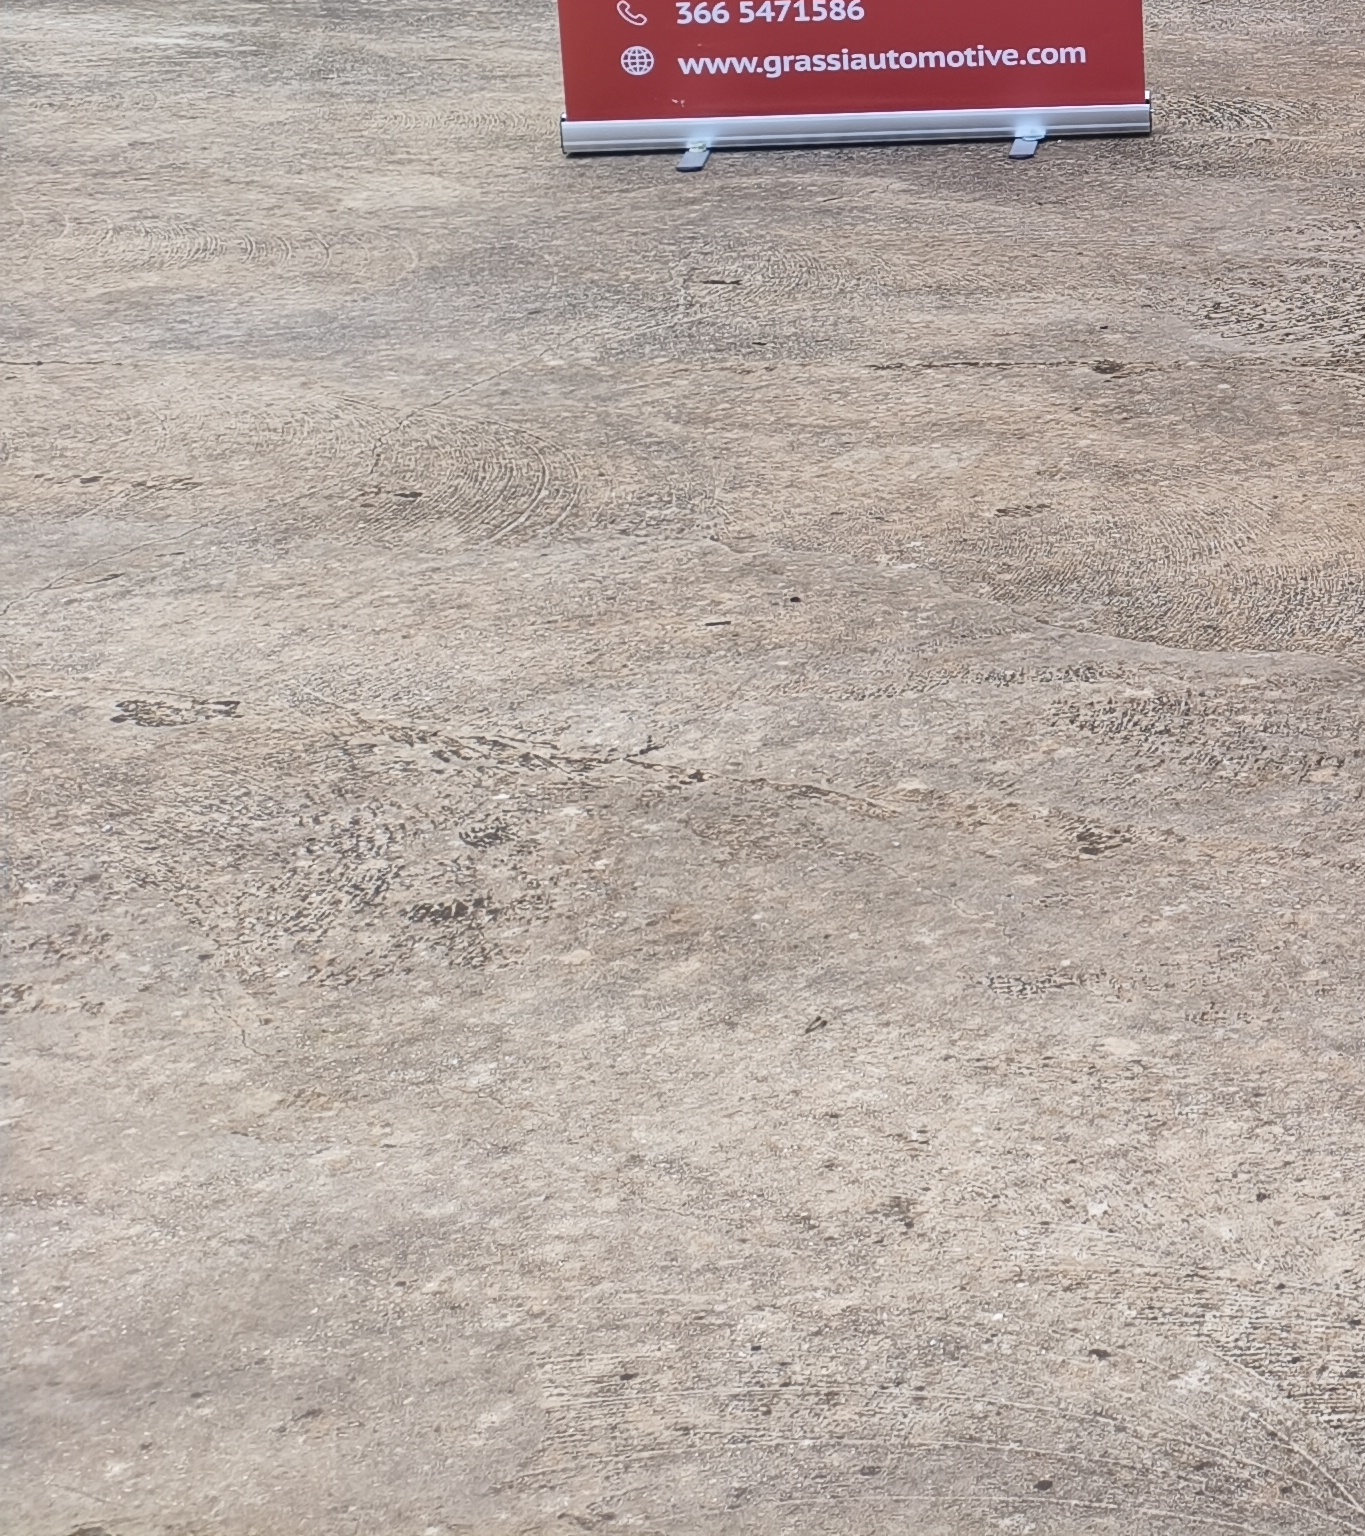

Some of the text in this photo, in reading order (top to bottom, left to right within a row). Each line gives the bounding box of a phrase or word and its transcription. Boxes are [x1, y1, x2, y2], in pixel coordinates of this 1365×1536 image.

[675, 0, 865, 25] 366 5471586
[677, 44, 1087, 78] www.grassiautomotive.com
